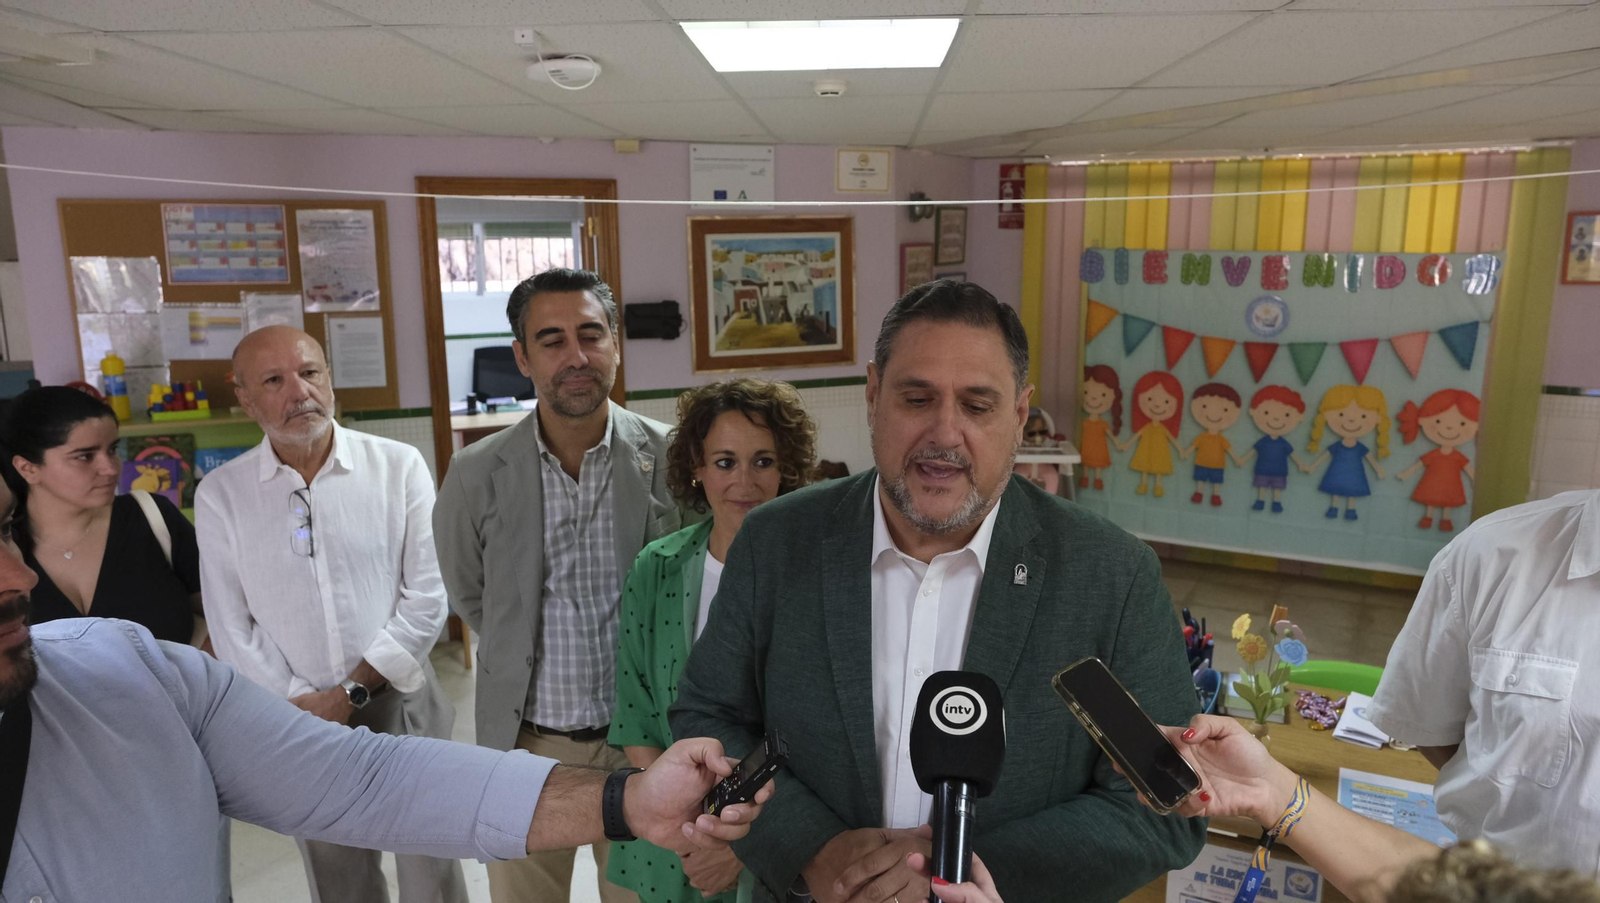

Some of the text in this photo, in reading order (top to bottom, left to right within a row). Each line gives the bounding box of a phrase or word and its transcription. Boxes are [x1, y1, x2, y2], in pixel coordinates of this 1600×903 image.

[1080, 247, 1501, 295] BIENVENIDOS
[945, 704, 972, 715] intv
[1210, 865, 1224, 877] LA
